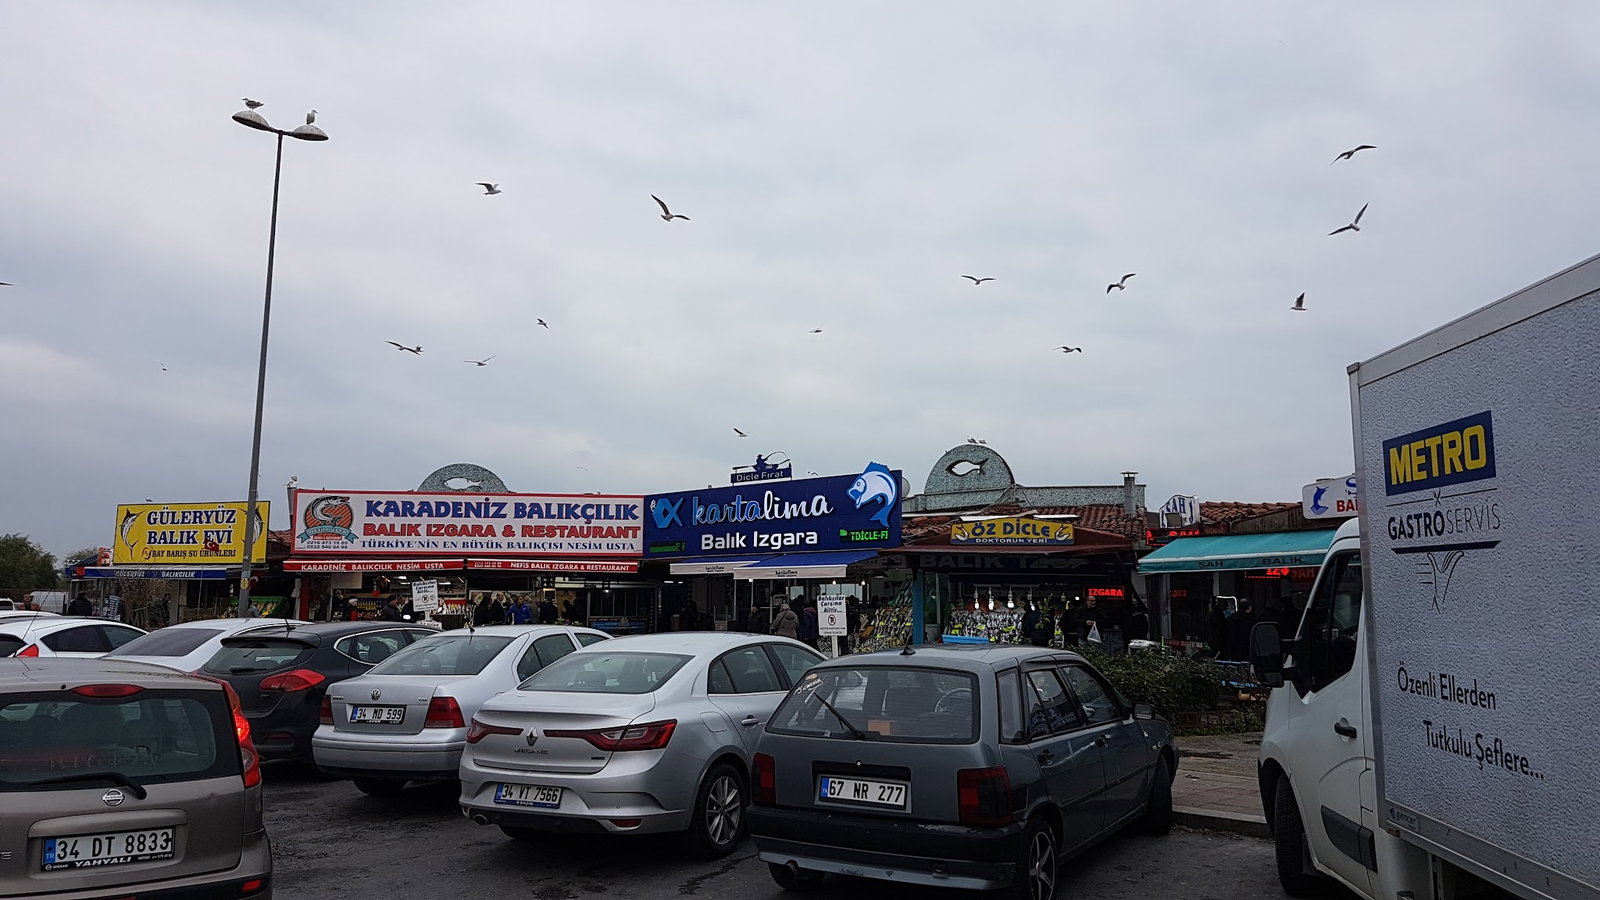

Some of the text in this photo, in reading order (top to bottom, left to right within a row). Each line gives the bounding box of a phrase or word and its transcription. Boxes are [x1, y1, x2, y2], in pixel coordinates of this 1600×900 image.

[1389, 424, 1487, 486] METRO
[736, 473, 760, 482] Dicle
[146, 504, 237, 525] GÜLERYÜZ
[365, 497, 639, 524] KARADENİZ BALIKÇILIK
[691, 490, 835, 527] kartalima
[146, 525, 233, 545] BALIK EVİ
[362, 523, 422, 537] BALIK
[426, 523, 497, 538] IZGARA
[502, 524, 516, 538] &
[521, 525, 641, 539] RESTAURANT
[971, 518, 1050, 537] ÖZ DİCLE
[360, 539, 439, 548] TÜRKİYE'NİN
[462, 539, 503, 549] BÜYÜK
[507, 542, 563, 551] BALIKÇISI
[567, 541, 602, 550] NESİM
[606, 542, 634, 550] USTA
[701, 532, 747, 551] Balık
[753, 531, 818, 551] Izgara
[152, 550, 165, 558] BAY
[166, 550, 187, 559] BARIŞ
[188, 550, 199, 558] SU
[919, 555, 1004, 569] BALIK
[1198, 557, 1304, 569] SAH BALIK
[301, 562, 346, 571] KARADENİZ
[351, 563, 393, 571] BALIKÇILIK
[396, 562, 421, 570] NESİM
[1087, 588, 1123, 597] IZGARA
[1397, 660, 1496, 710] Özenli Ellerden
[357, 708, 367, 719] 34
[386, 709, 403, 720] 599
[1422, 719, 1473, 759] Tutkulu
[502, 784, 559, 802] 34 VT 7566
[829, 780, 903, 803] 67 NR 277
[57, 840, 80, 860] 34
[92, 836, 116, 857] DT
[125, 831, 171, 854] 8833
[45, 852, 55, 860] TR
[75, 856, 132, 868] YAHYALI
